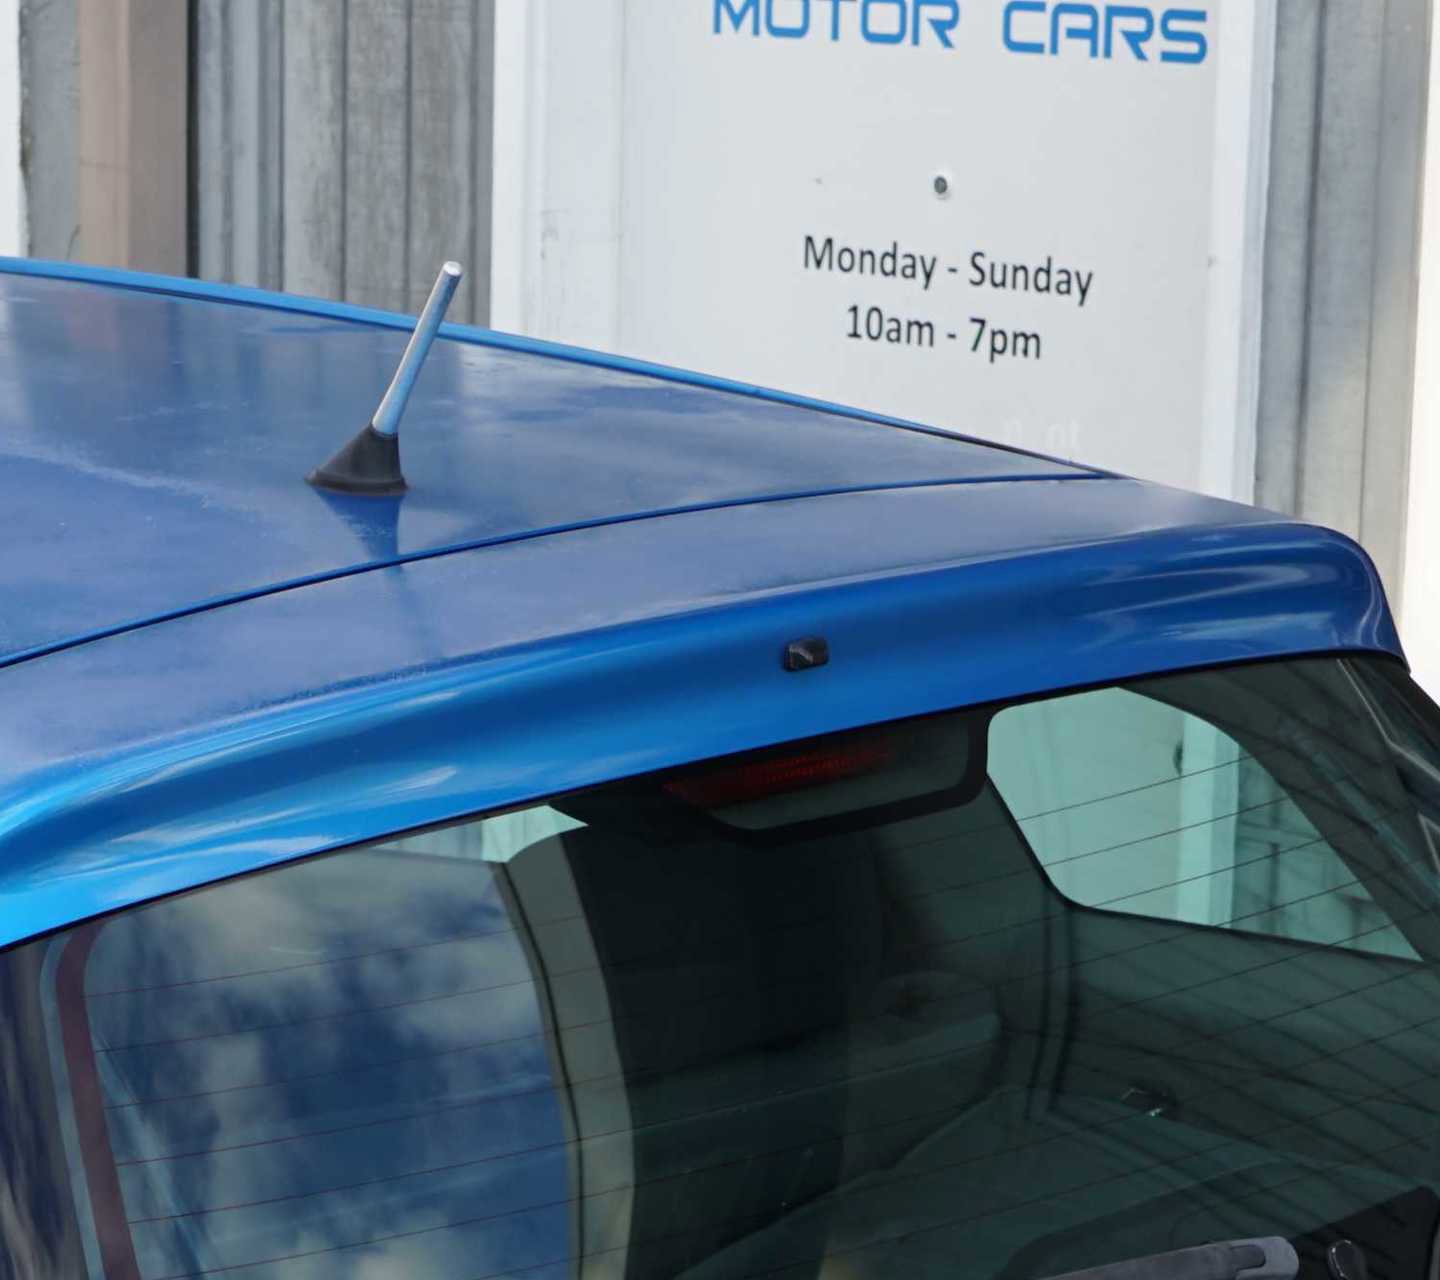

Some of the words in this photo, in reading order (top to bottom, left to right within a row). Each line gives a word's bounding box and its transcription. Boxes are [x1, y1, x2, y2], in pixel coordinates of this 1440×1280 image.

[713, 0, 960, 49] MOTOR
[1002, 2, 1208, 64] CARS
[803, 235, 937, 290] Monday
[969, 251, 1094, 306] Sunday
[845, 305, 936, 349] 10am
[969, 318, 1042, 361] 7pm
